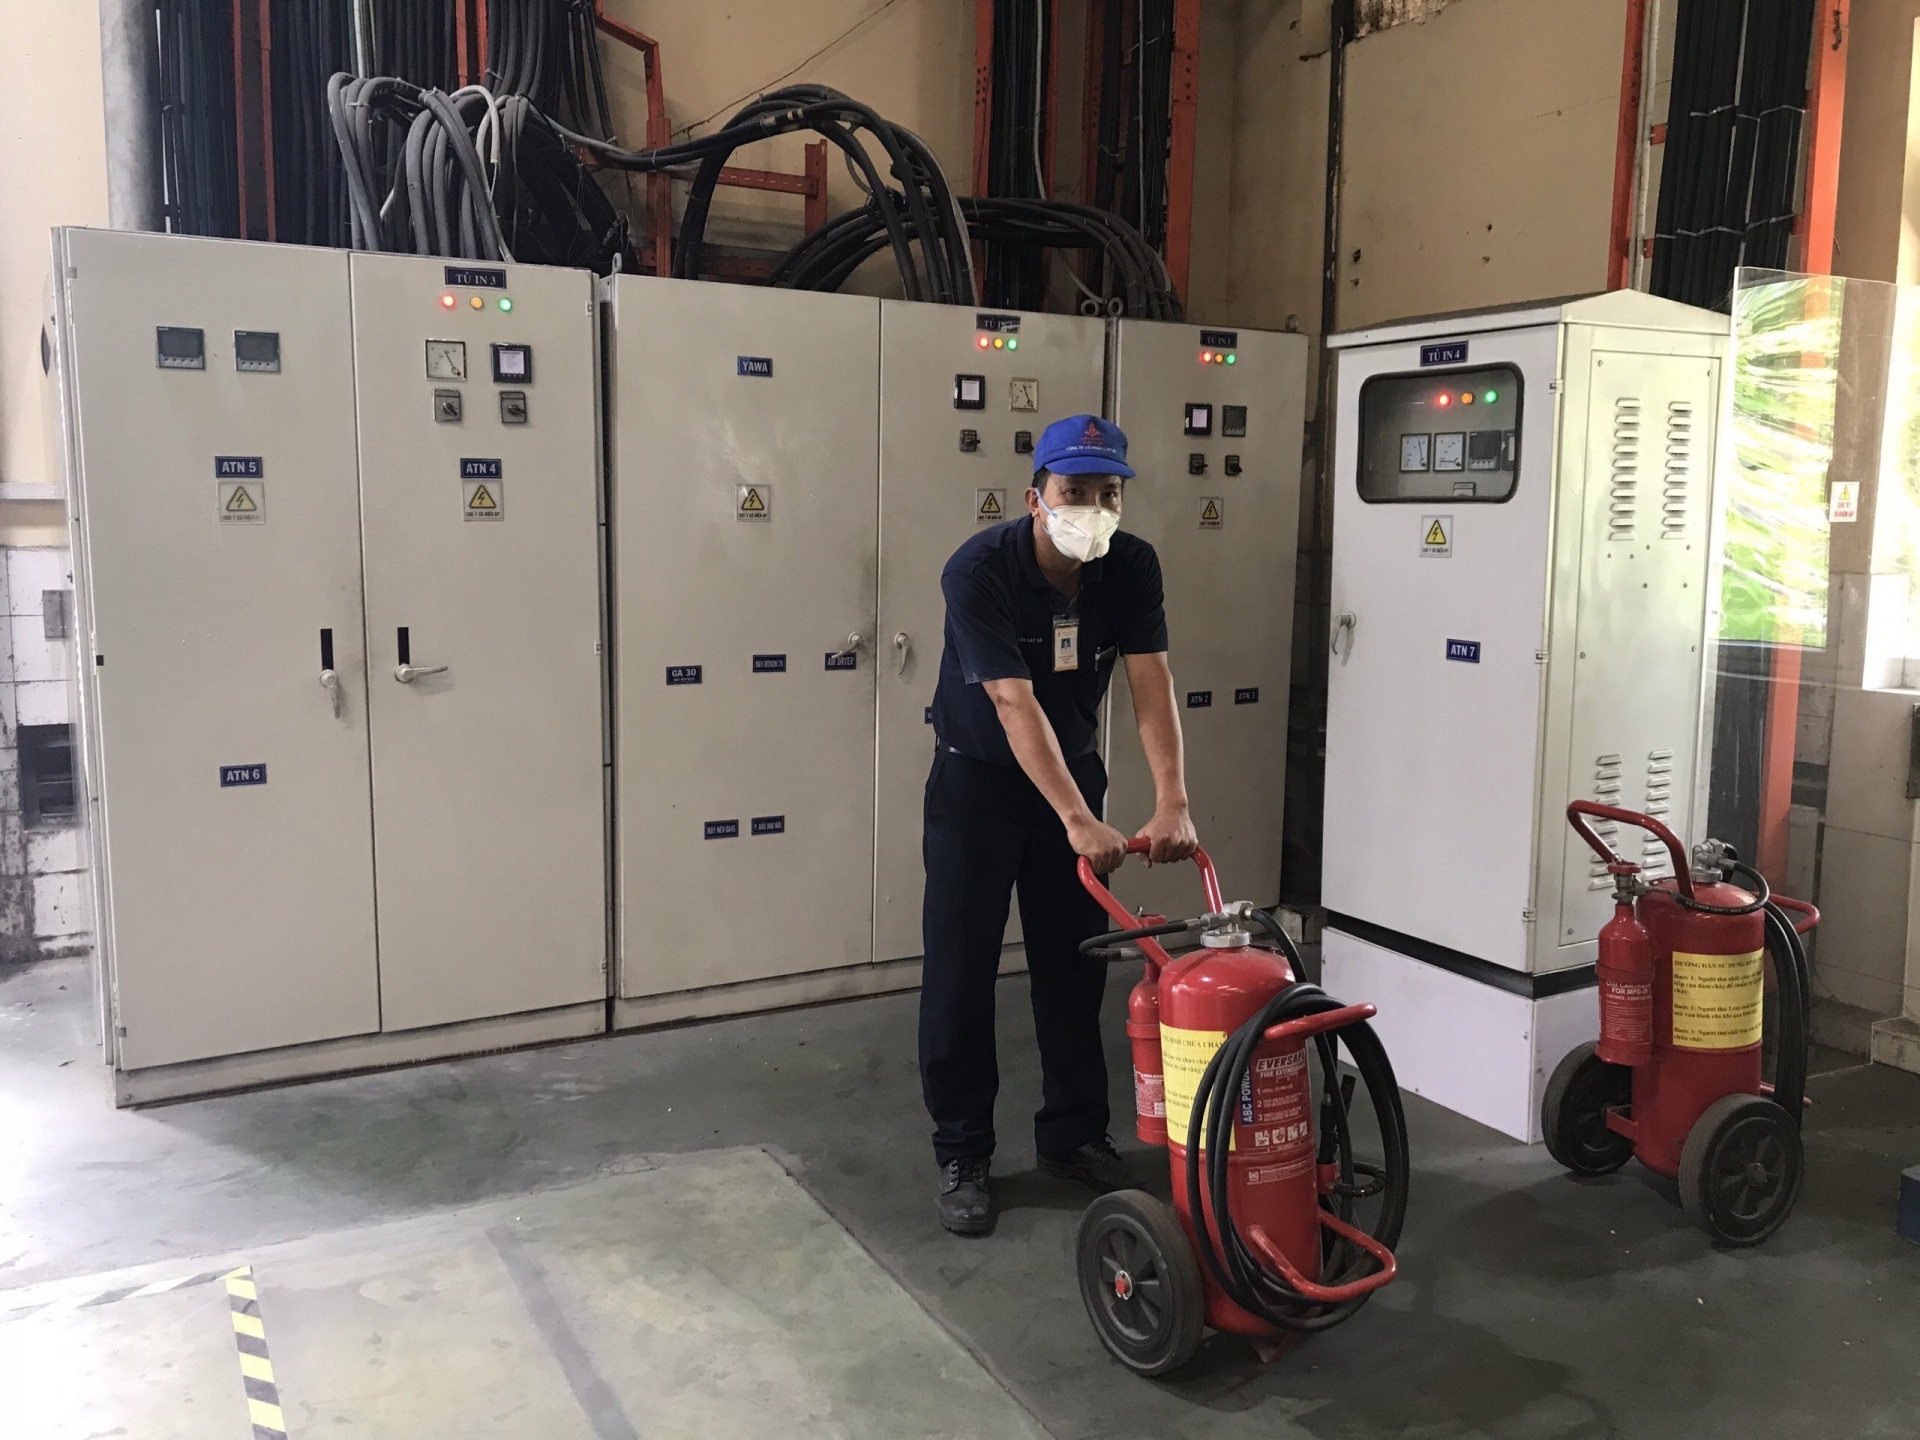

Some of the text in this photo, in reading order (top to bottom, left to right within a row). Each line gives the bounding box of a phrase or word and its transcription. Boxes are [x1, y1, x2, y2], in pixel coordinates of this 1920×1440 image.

[455, 271, 497, 286] TỦ IN 3
[1428, 348, 1460, 361] TỦ IN 4
[742, 361, 769, 373] YAWA
[221, 461, 257, 473] ATN 5
[465, 463, 497, 474] ATN 4
[1450, 644, 1476, 657] ATN 7
[671, 668, 697, 677] GA 30
[1190, 694, 1209, 704] ATN 2
[1238, 691, 1256, 700] ATN 3
[226, 768, 261, 782] ATN 6
[1611, 987, 1626, 995] FOR
[1257, 1100, 1263, 1108] 2
[1242, 1103, 1254, 1123] ABC
[1257, 1113, 1263, 1121] 3
